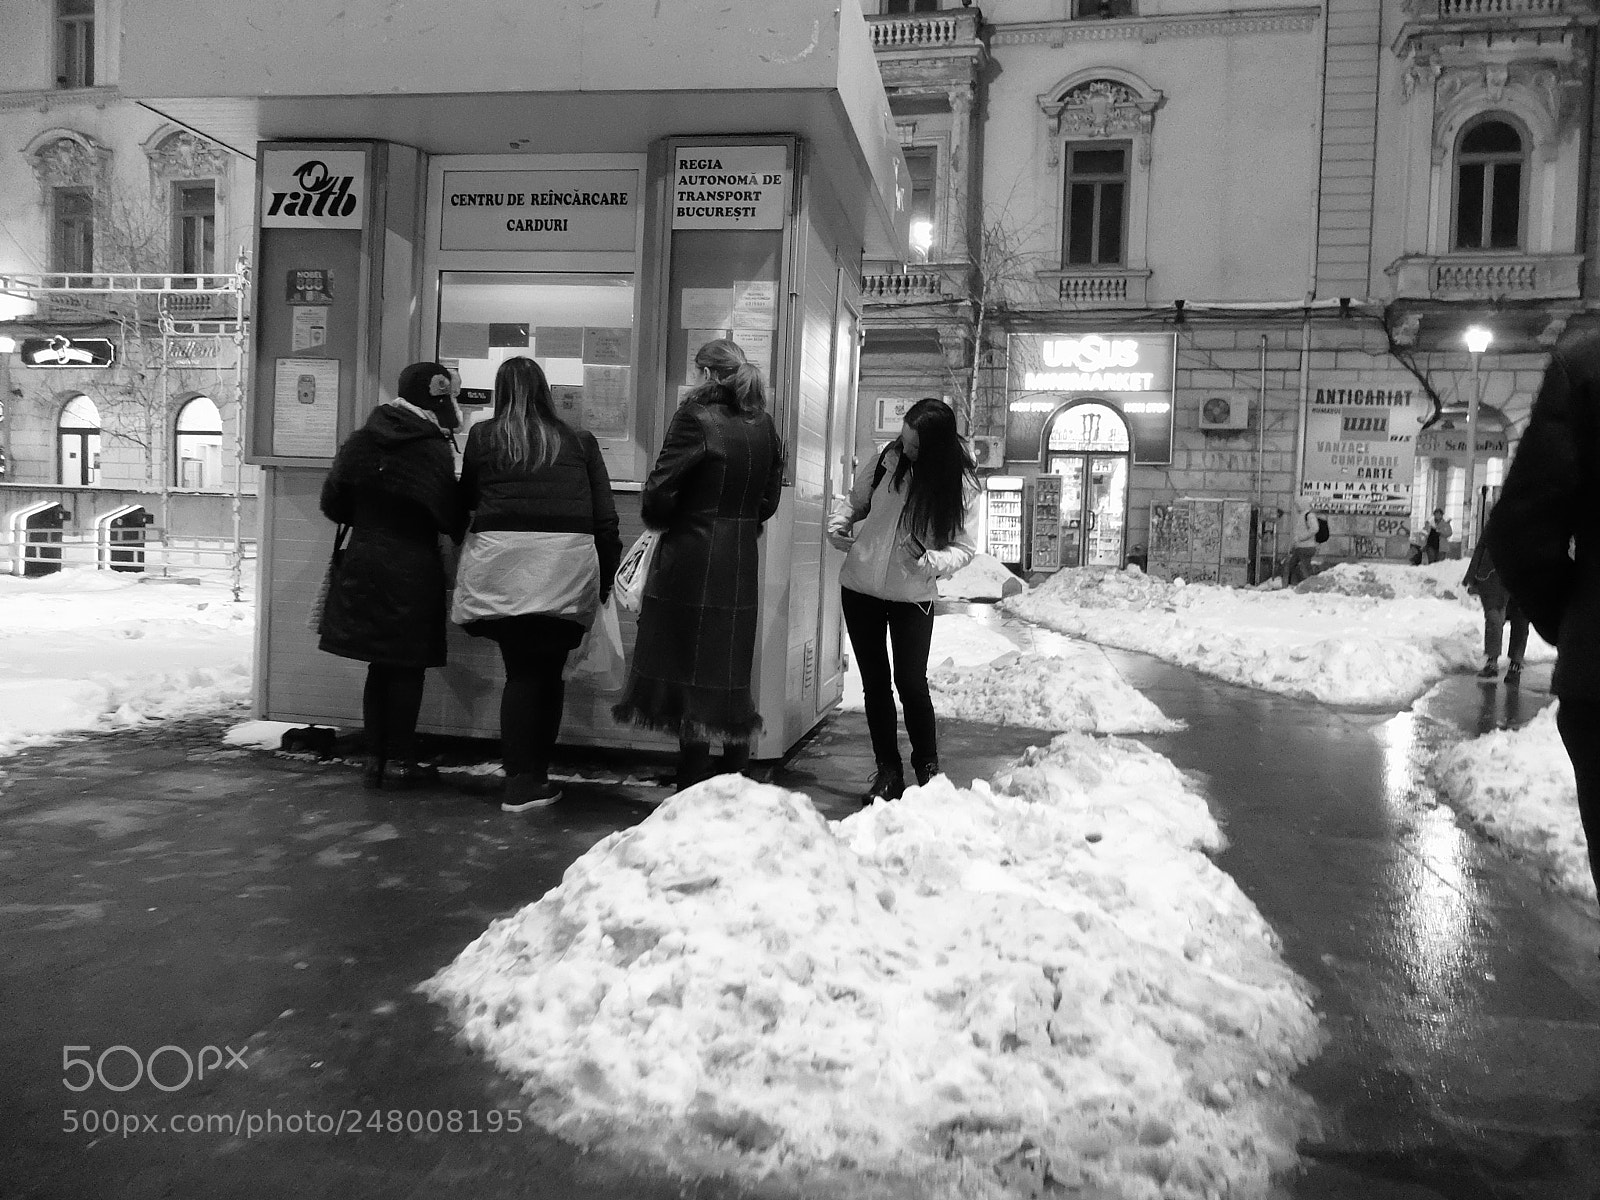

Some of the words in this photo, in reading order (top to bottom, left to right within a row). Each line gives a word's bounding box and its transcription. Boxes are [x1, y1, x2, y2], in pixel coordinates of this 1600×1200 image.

[679, 159, 723, 170] REGIA
[678, 172, 759, 186] AUTONOMĂ
[762, 174, 782, 185] DE
[450, 193, 504, 206] CENTRU
[506, 193, 525, 206] DE
[530, 189, 628, 206] REÎNCĂRCARE
[677, 191, 762, 202] TRANSPORT
[506, 218, 568, 232] CARDURI
[1043, 335, 1139, 373] URSUS
[1315, 388, 1414, 407] ANTICARIAT
[1356, 467, 1394, 480] CARTE
[1345, 482, 1411, 493] MARKET
